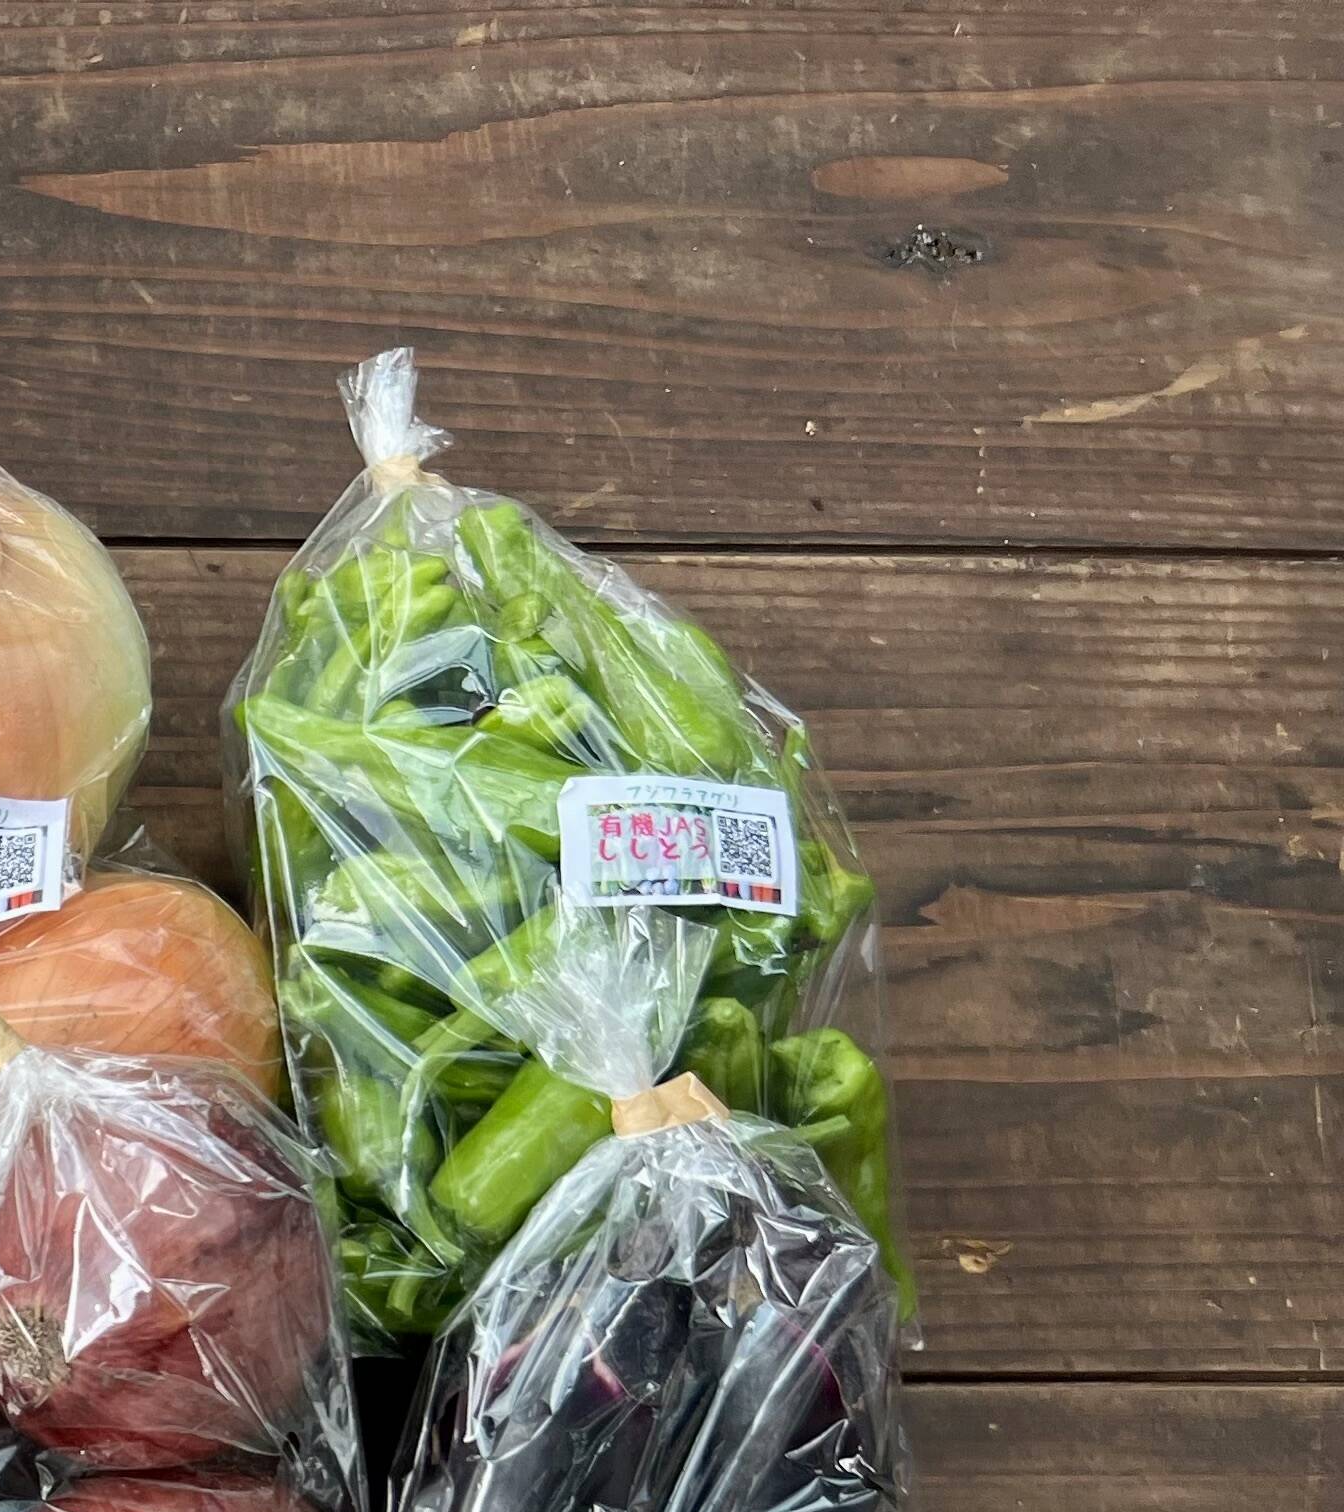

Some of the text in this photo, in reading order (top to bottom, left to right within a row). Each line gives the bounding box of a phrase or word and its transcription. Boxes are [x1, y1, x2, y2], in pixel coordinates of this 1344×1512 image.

[626, 787, 739, 806] フジワラアグリ
[599, 813, 707, 838] 有機JAS
[599, 838, 709, 861] ししとう
